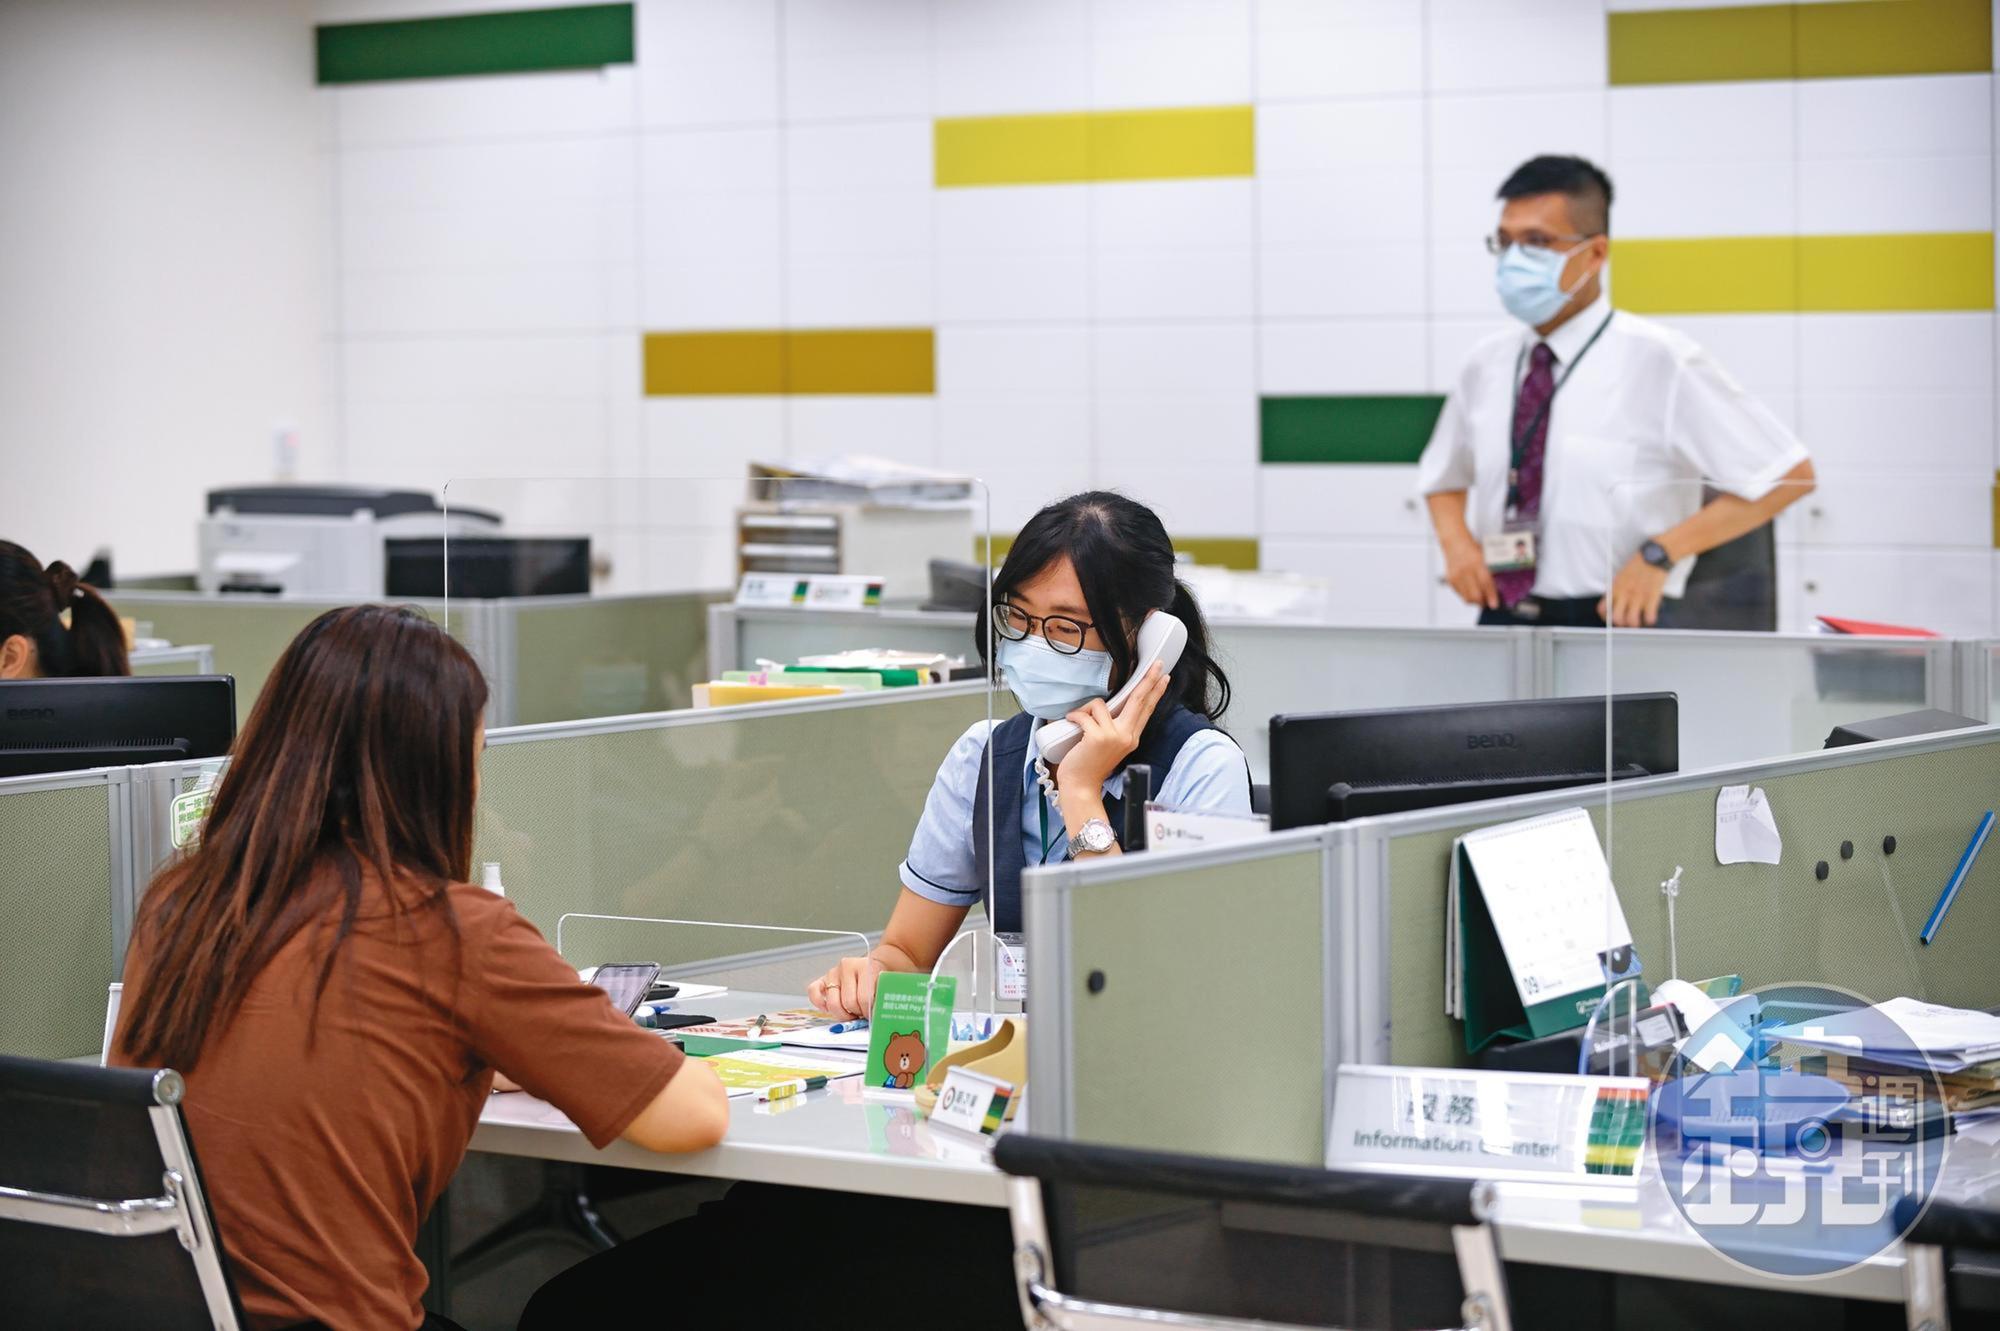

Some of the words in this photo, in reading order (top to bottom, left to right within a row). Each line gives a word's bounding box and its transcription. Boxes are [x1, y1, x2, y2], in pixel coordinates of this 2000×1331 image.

[1466, 732, 1517, 750] BenQ
[1406, 1092, 1512, 1126] 服務
[1353, 1128, 1472, 1154] Information
[1479, 1136, 1560, 1158] Cnter
